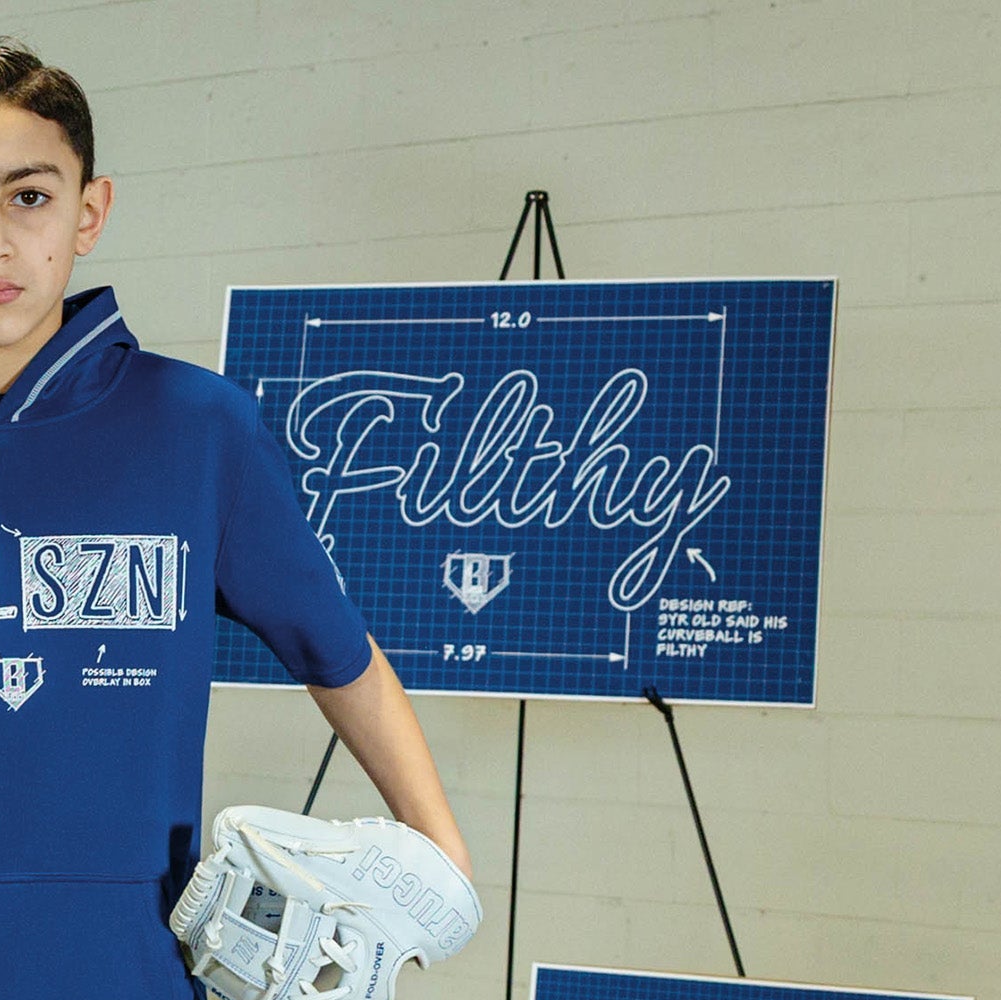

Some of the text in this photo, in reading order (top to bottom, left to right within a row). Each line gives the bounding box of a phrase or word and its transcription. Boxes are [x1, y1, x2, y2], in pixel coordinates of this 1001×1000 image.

[490, 311, 532, 329] 12.0
[286, 369, 731, 611] Filthy
[659, 598, 752, 613] DESIGN REF:
[658, 613, 788, 629] 9YR OLD SAID HIS
[657, 628, 763, 644] CURVEBALL IS
[443, 643, 487, 662] 7.97
[656, 643, 707, 658] FILTHY
[82, 668, 157, 677] POSSIBLE DESIGN
[82, 677, 151, 686] OVERLAY IN BOX
[351, 844, 475, 957] arucci
[365, 941, 384, 999] FOLD-OVER
